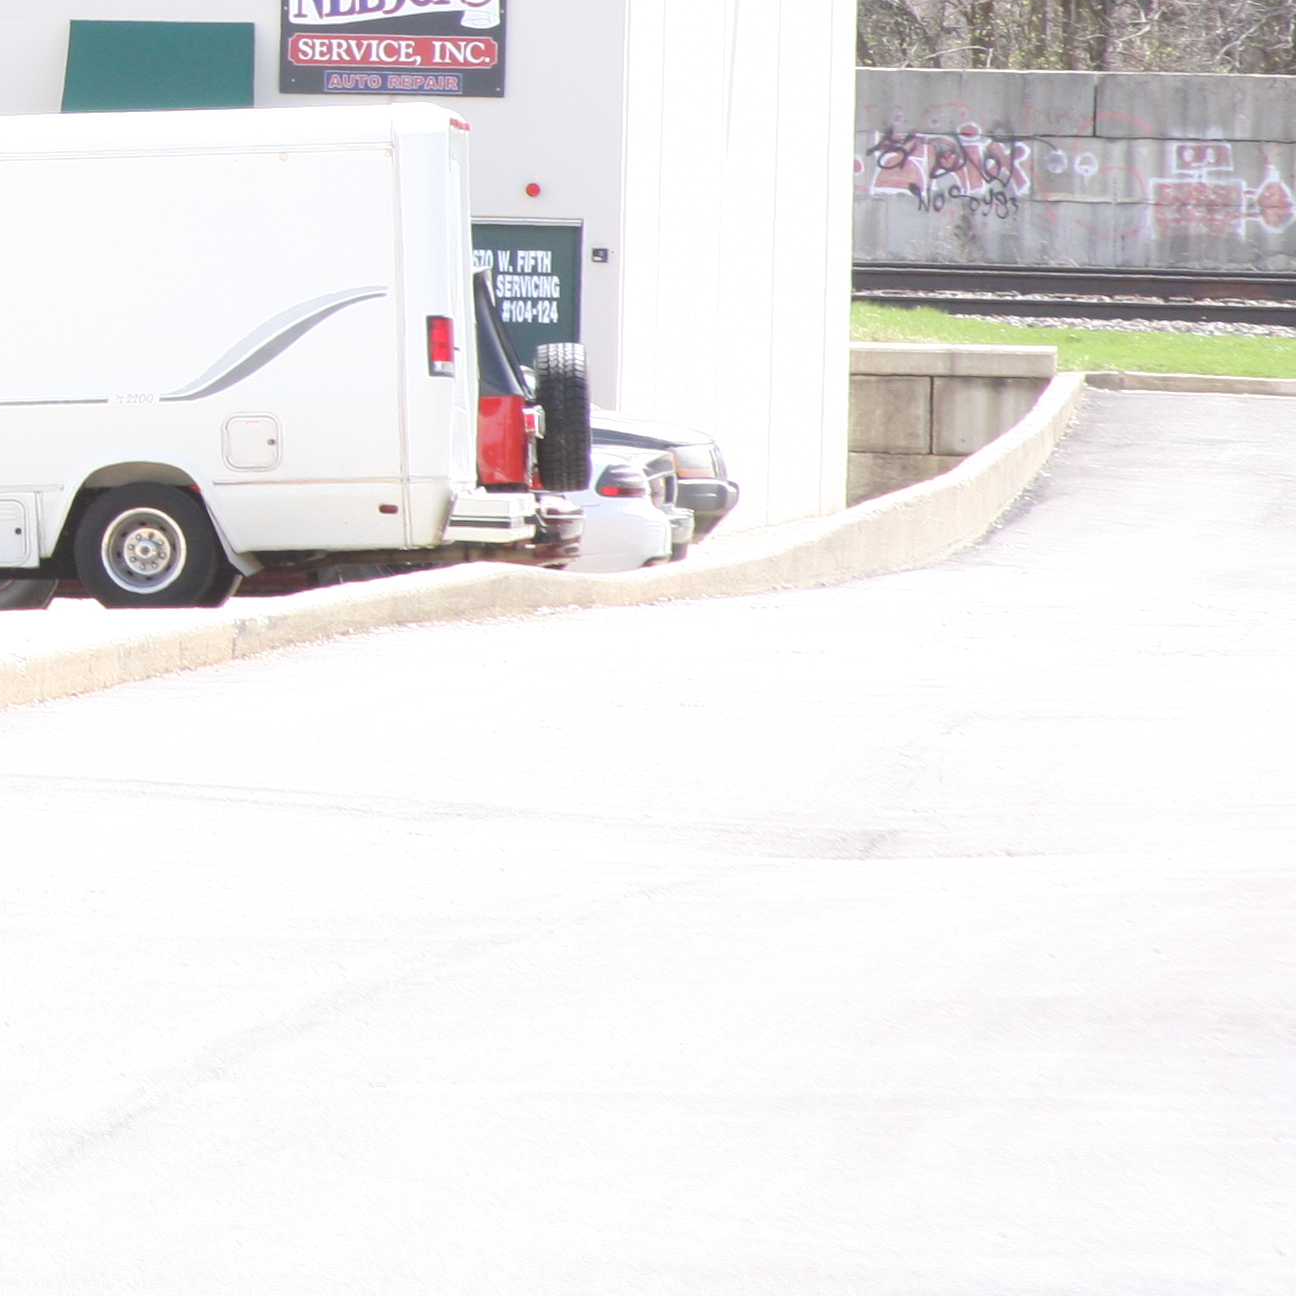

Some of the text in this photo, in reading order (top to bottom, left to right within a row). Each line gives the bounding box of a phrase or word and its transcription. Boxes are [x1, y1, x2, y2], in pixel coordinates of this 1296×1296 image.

[297, 37, 491, 66] SERVICE, INC.
[327, 74, 459, 90] AUTO REPAIR
[497, 250, 513, 273] W.
[517, 251, 552, 273] FIFTH
[496, 275, 561, 298] SERVICING
[501, 300, 559, 323] #104-124
